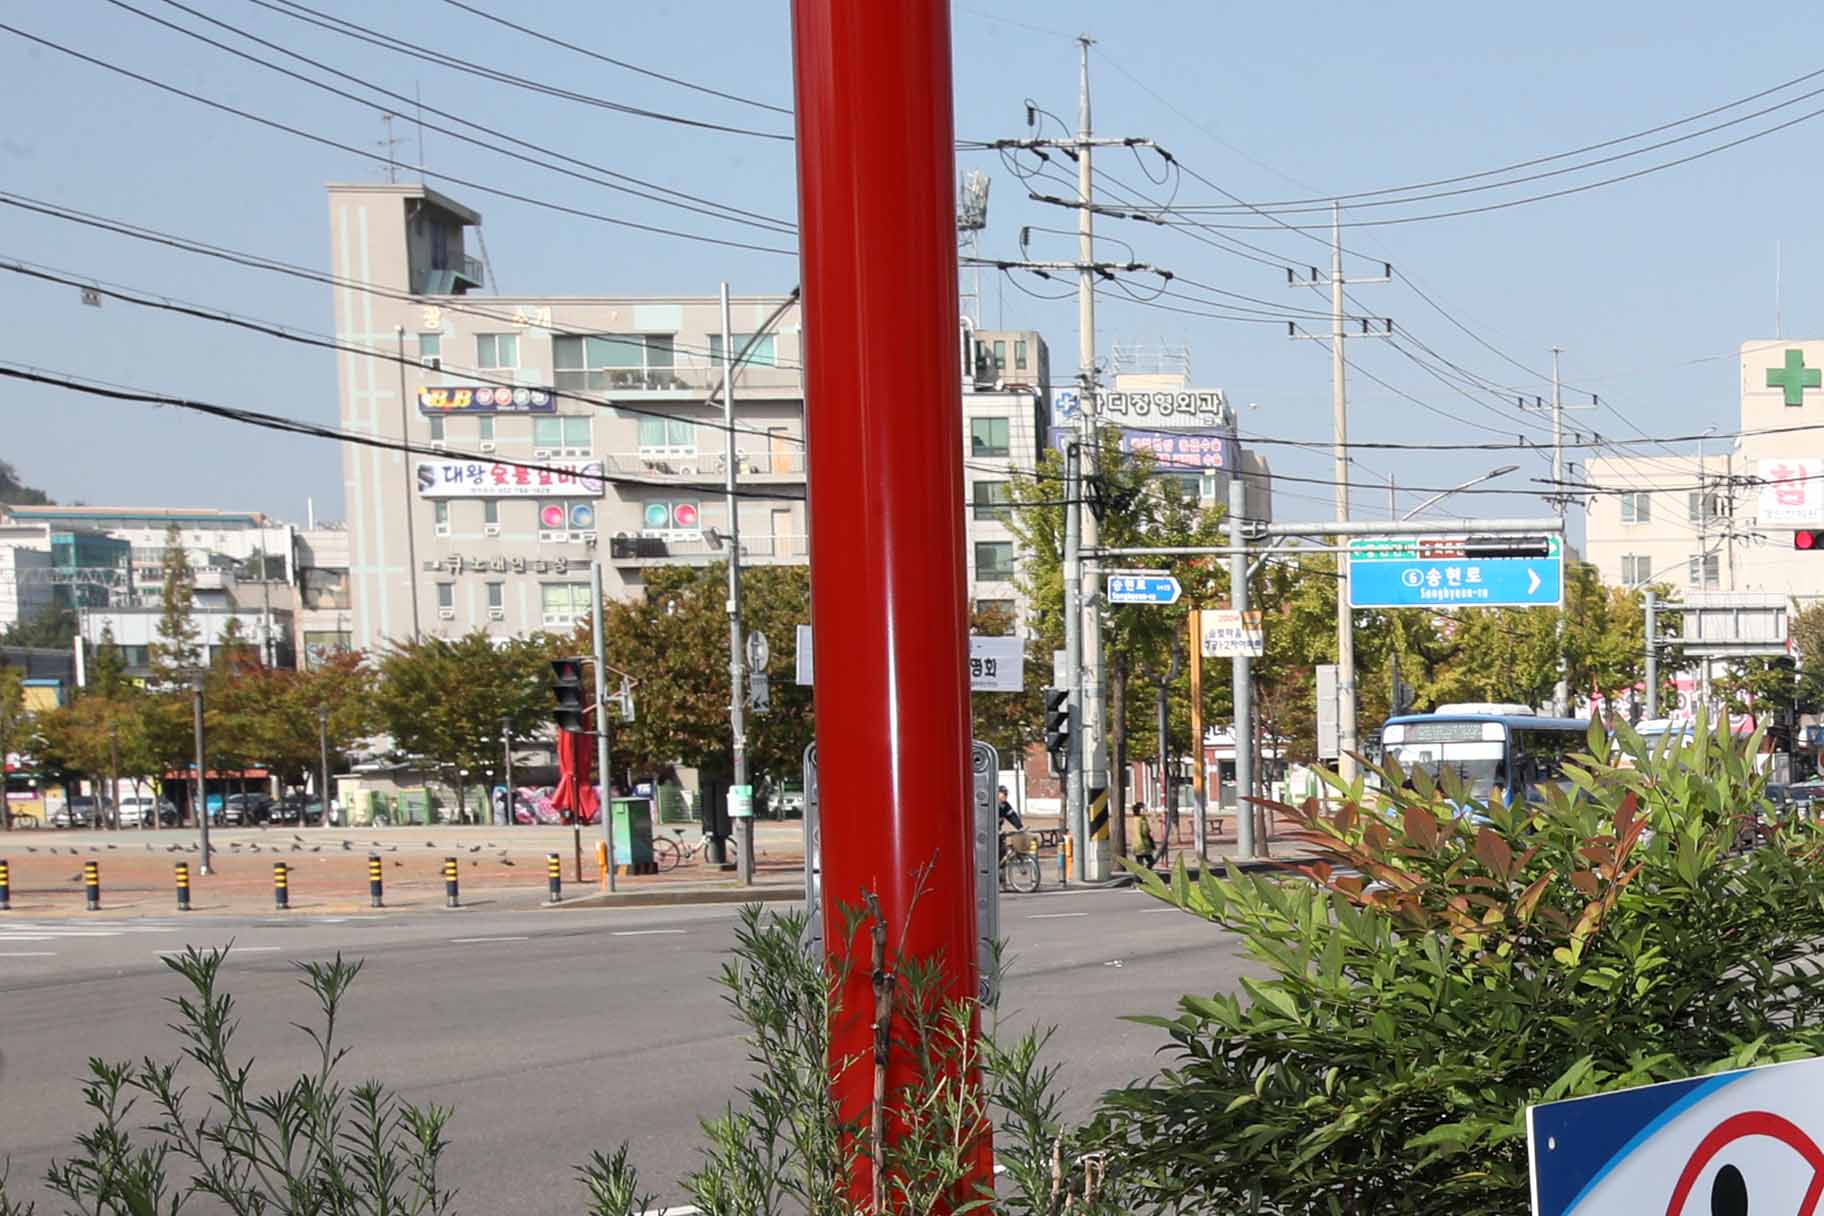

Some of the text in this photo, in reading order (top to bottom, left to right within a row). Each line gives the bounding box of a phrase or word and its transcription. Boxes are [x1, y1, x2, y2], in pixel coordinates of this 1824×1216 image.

[442, 464, 487, 485] 대왕
[1770, 463, 1808, 506] 침
[1426, 567, 1482, 587] 송현로
